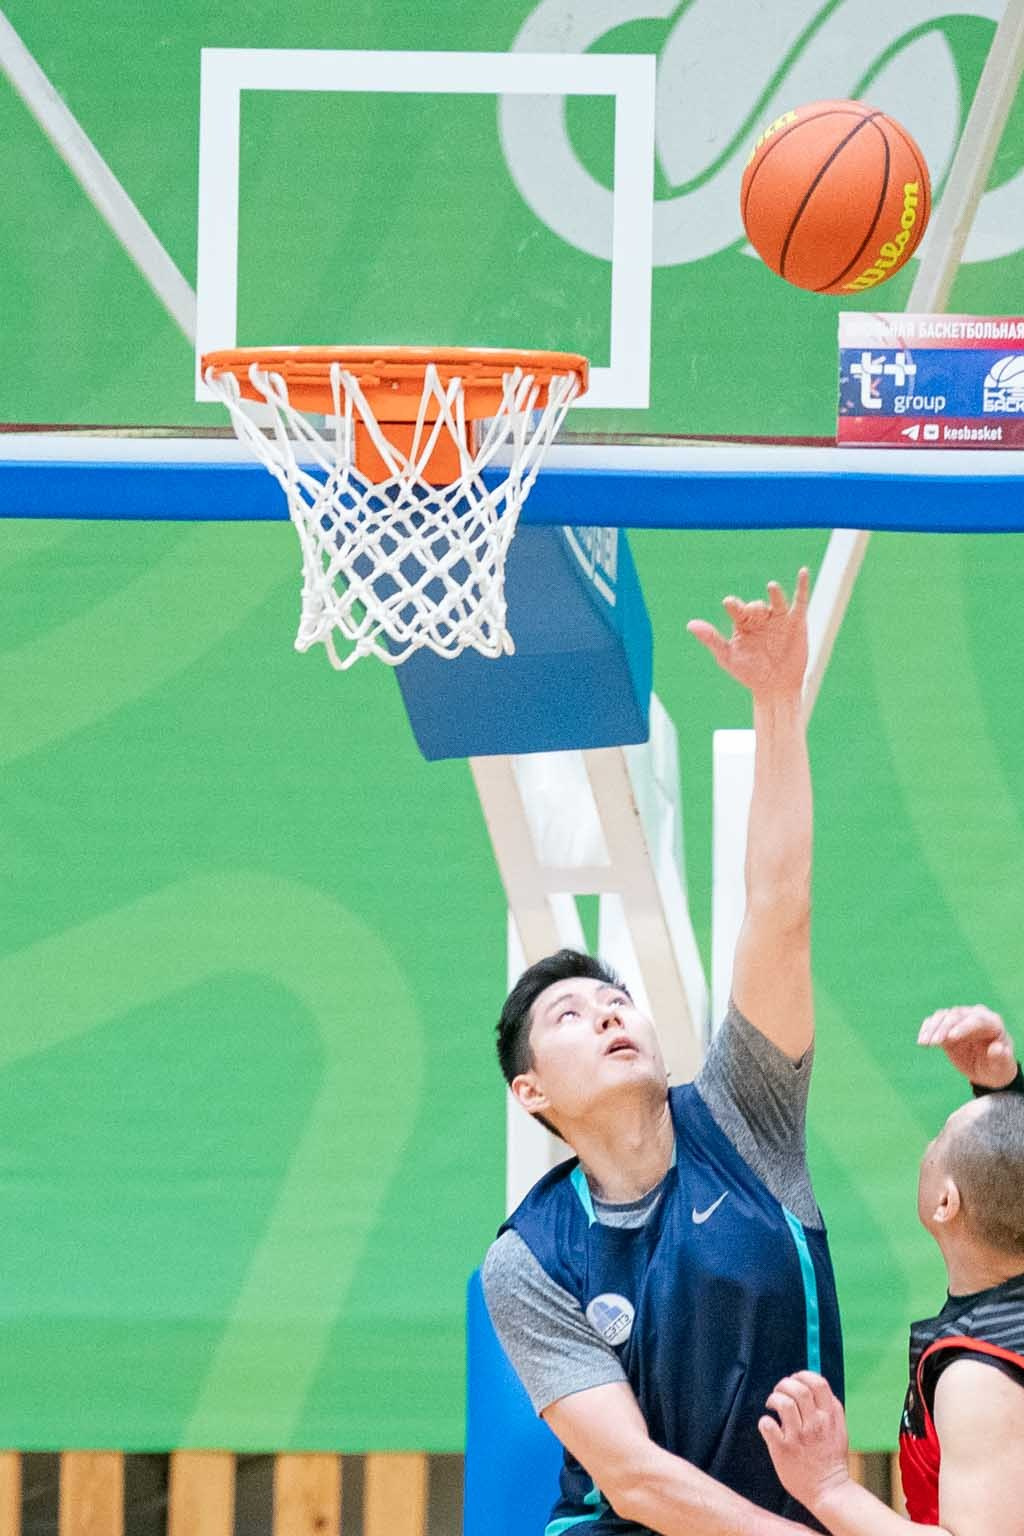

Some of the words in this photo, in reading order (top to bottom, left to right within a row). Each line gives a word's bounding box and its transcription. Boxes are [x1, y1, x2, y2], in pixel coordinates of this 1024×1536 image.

[842, 180, 919, 290] Wilson
[894, 395, 946, 413] group
[943, 425, 1003, 441] kesbasket
